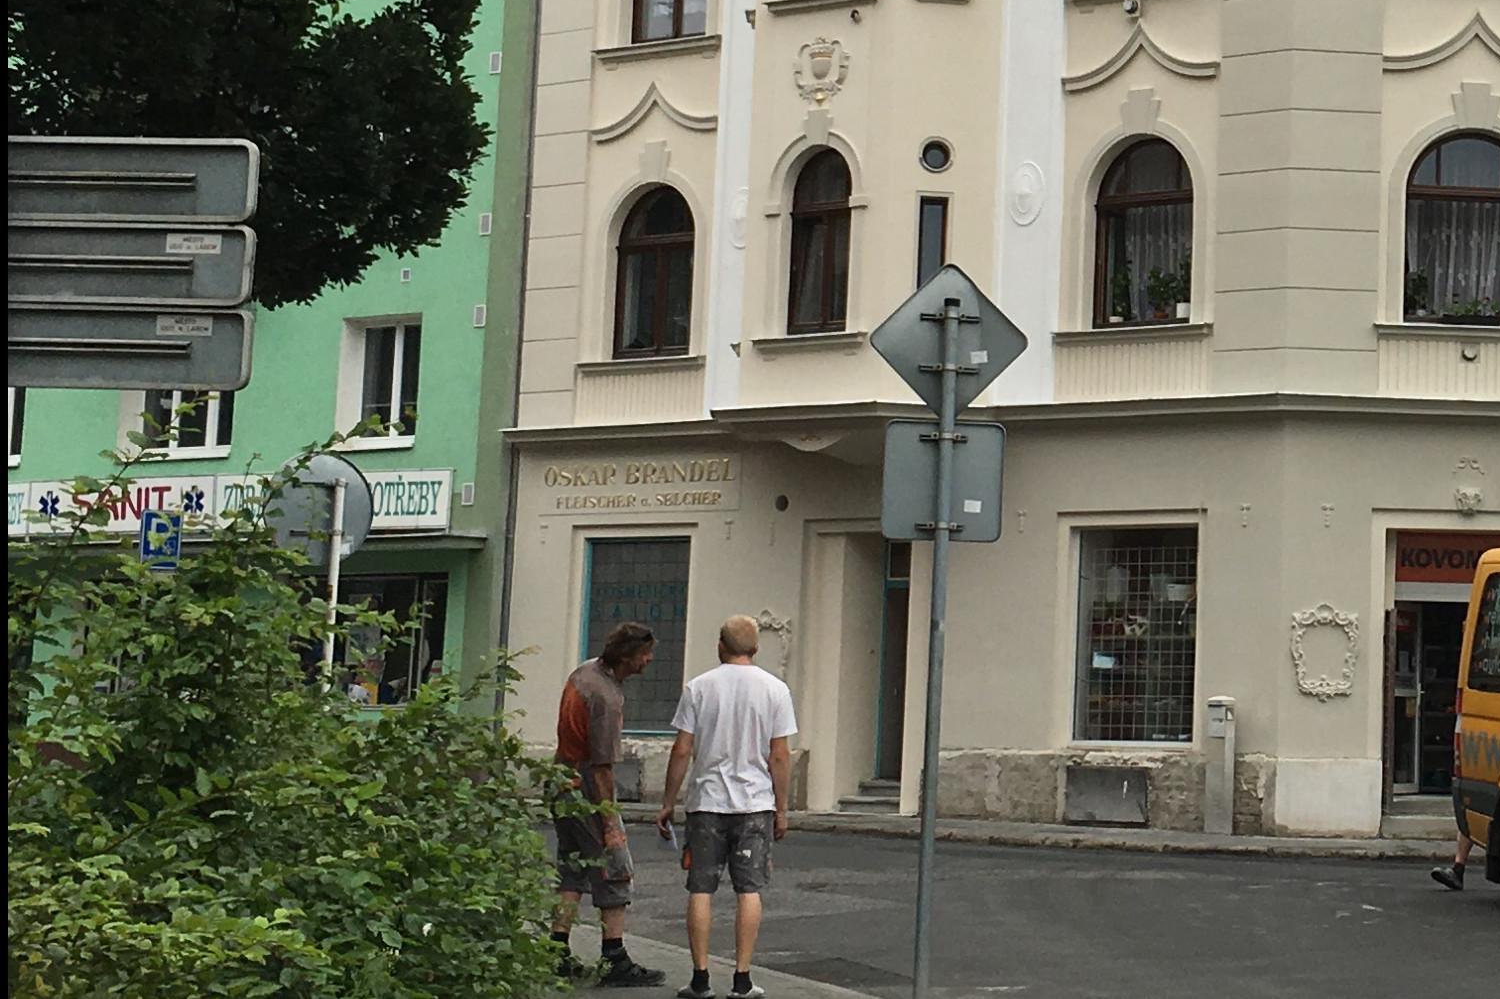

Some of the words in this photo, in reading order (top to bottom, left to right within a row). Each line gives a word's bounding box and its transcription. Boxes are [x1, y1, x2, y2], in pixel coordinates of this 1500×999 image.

[544, 463, 617, 488] OSKAR
[625, 458, 736, 485] BRANDEL
[371, 475, 443, 517] OTŘEBY
[556, 493, 636, 510] FLEISCHER
[655, 490, 722, 507] SELCHER
